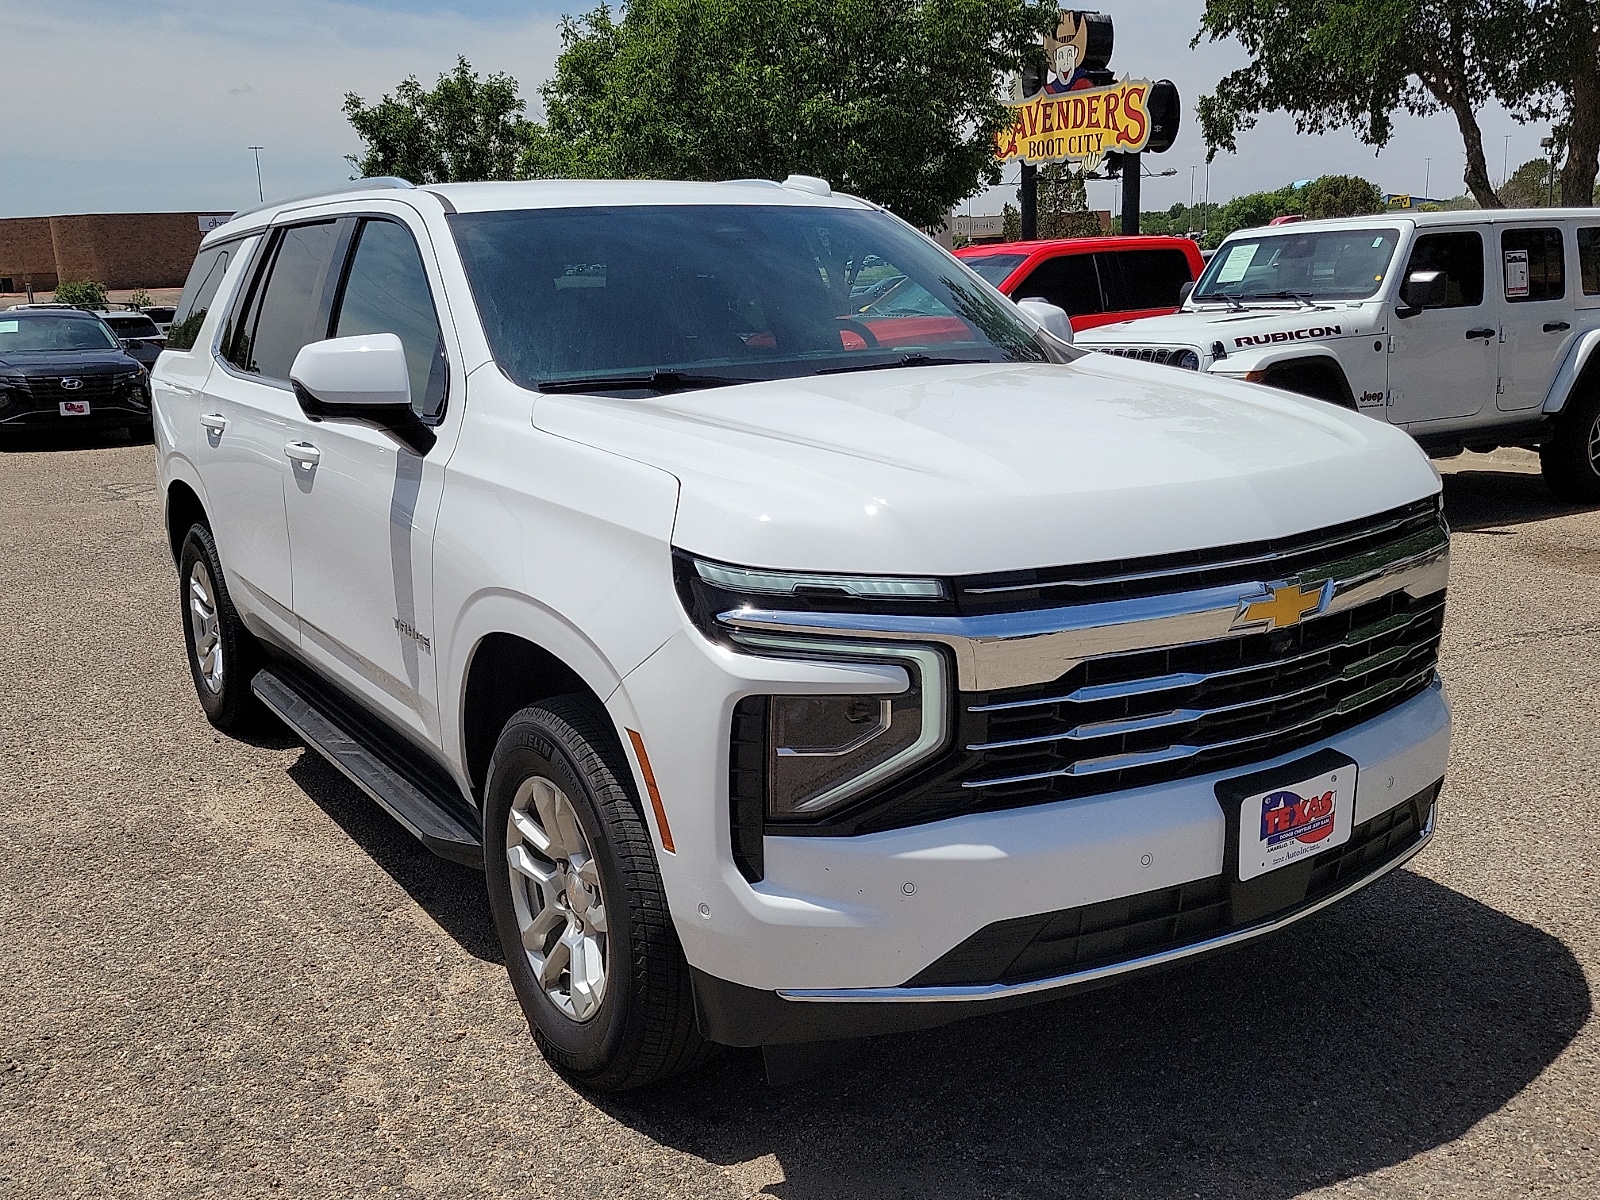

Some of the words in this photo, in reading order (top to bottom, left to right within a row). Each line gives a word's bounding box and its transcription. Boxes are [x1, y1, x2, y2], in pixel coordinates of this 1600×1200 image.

[994, 87, 1146, 158] CAVENDER'S
[1028, 138, 1064, 159] BOOT
[1068, 133, 1103, 154] CITY
[1234, 325, 1342, 348] RUBICON
[1360, 391, 1383, 402] Jeep
[1265, 791, 1333, 834] TEXAS
